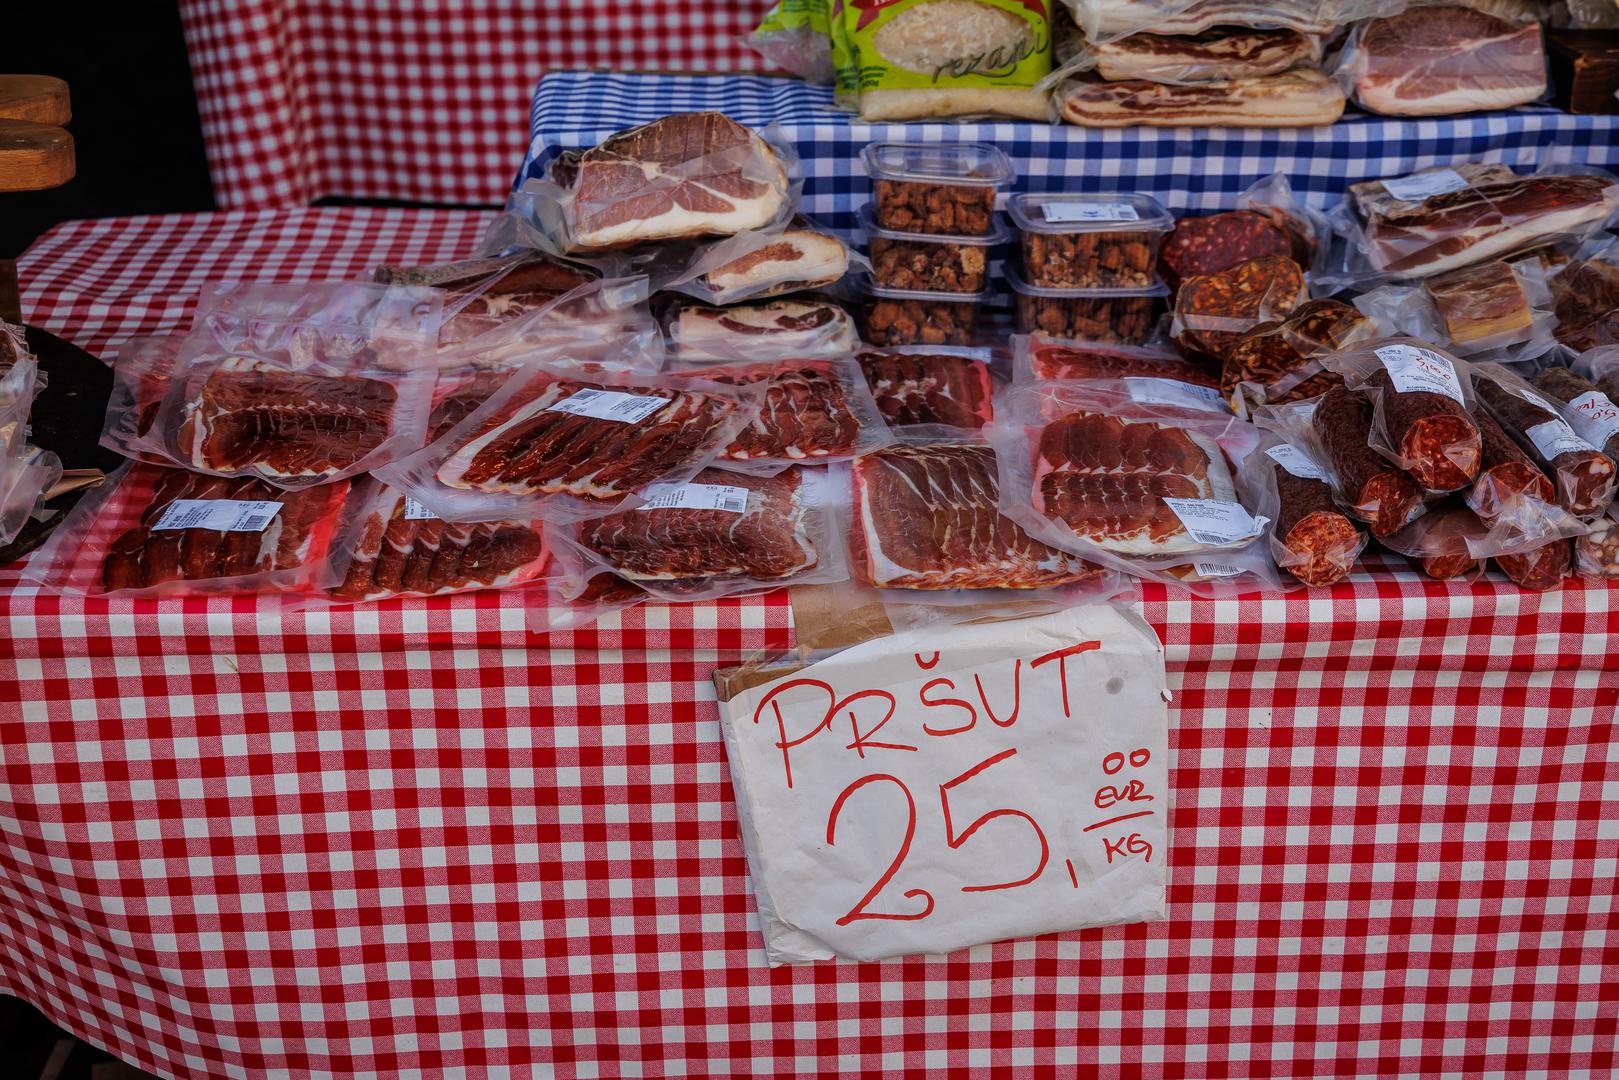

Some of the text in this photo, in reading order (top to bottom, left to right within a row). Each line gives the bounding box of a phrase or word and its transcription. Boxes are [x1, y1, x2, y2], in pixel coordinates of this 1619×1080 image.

[932, 18, 1049, 84] rezani
[754, 640, 1101, 789] PRŠUT
[1095, 779, 1154, 809] EUR
[1102, 833, 1154, 863] KG
